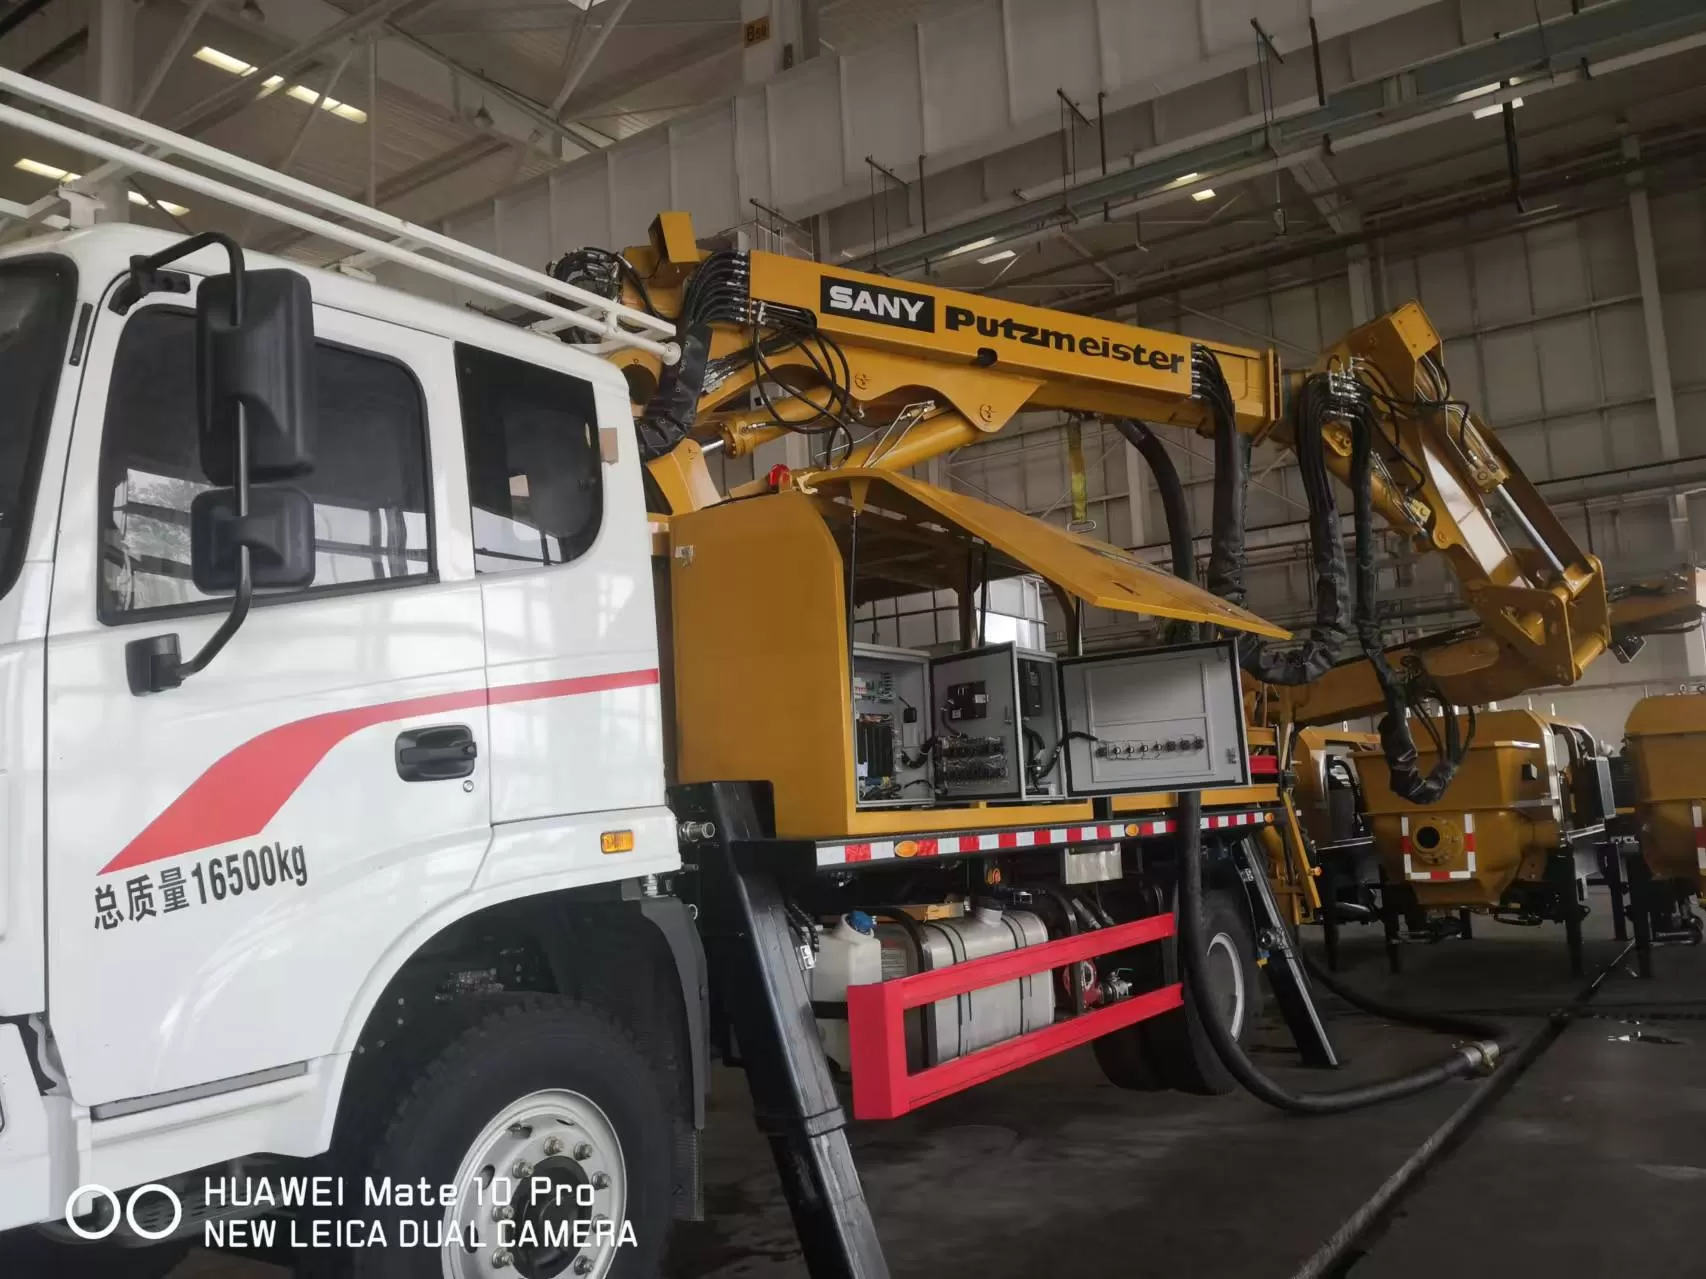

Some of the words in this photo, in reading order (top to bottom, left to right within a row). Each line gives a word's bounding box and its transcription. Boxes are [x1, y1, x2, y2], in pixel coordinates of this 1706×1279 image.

[829, 285, 925, 322] SANY
[945, 305, 1185, 374] Putzmeister
[94, 841, 308, 931] 总质量16500kg
